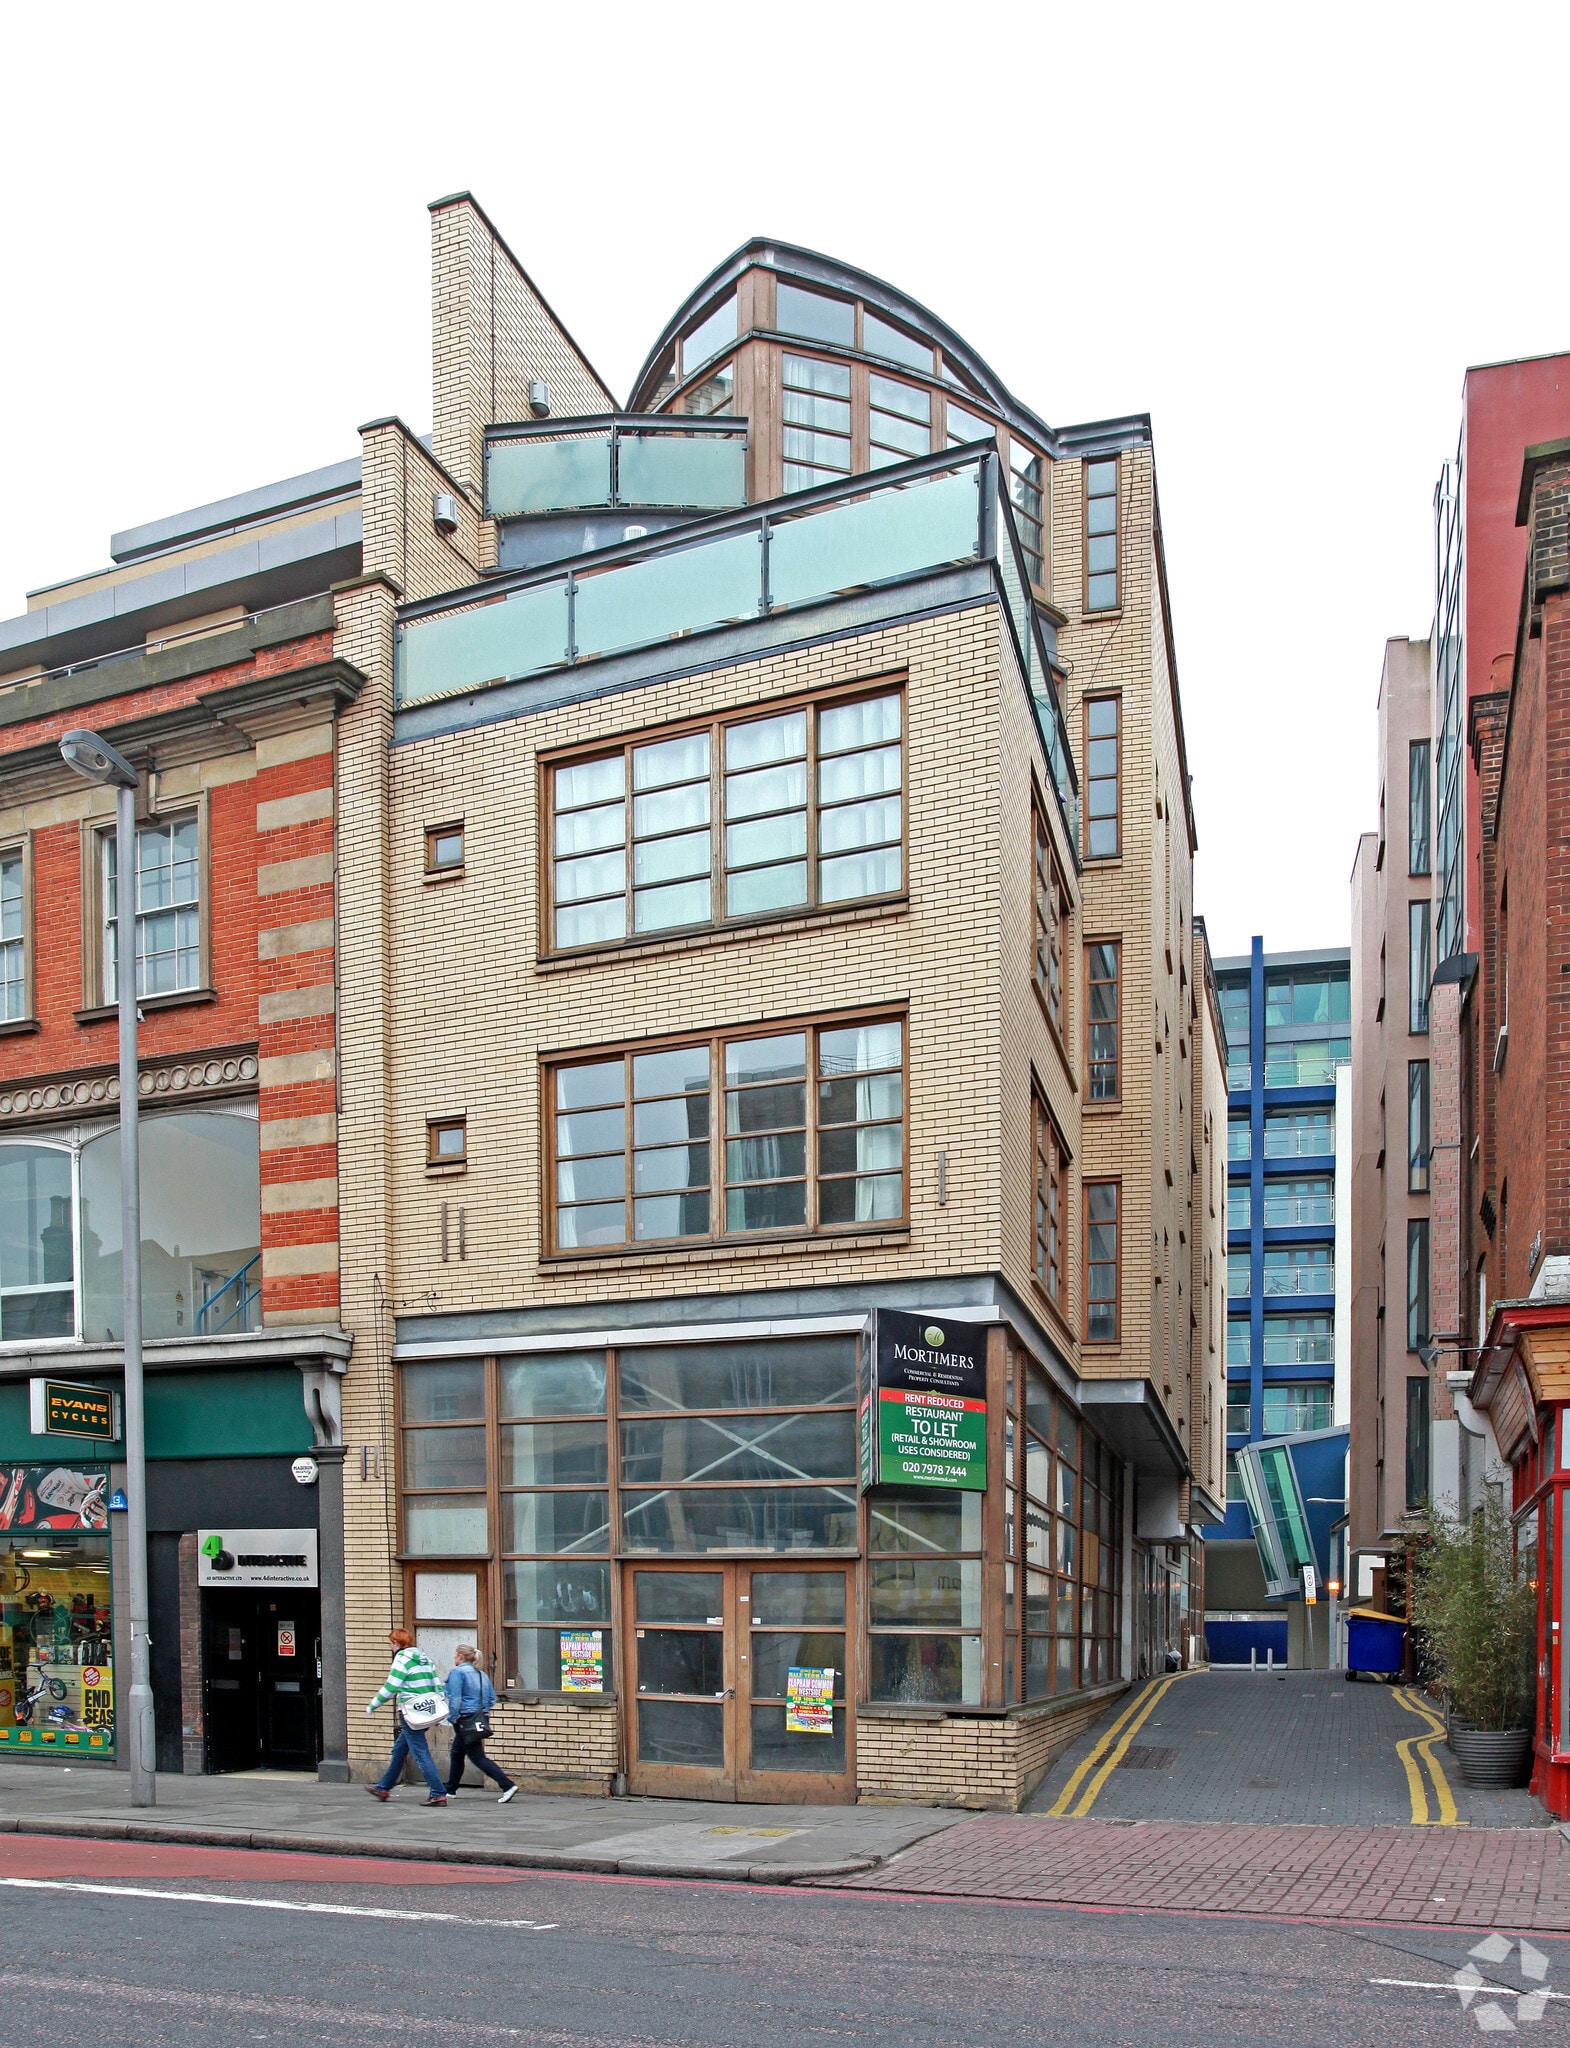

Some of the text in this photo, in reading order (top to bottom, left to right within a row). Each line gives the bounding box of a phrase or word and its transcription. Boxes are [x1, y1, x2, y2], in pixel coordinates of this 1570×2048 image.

[894, 1344, 974, 1369] MORTIMERS
[51, 1397, 108, 1413] EVANS
[904, 1394, 964, 1408] RENT REDUCED
[51, 1410, 108, 1425] CYCLES
[905, 1406, 964, 1421] RESTAURANT
[911, 1419, 958, 1437] TO LET
[891, 1433, 976, 1450] (RETAIL & SHOWROOM
[898, 1445, 970, 1461] USES CONSIDERED)
[903, 1462, 967, 1476] 020 7978 7444
[238, 1555, 307, 1566] INTERACTIVE
[561, 1642, 581, 1651] CLAPHAM
[788, 1678, 810, 1688] CLAPHAM
[85, 1689, 110, 1708] END
[413, 1698, 435, 1712] Gola
[85, 1708, 114, 1725] SEAS
